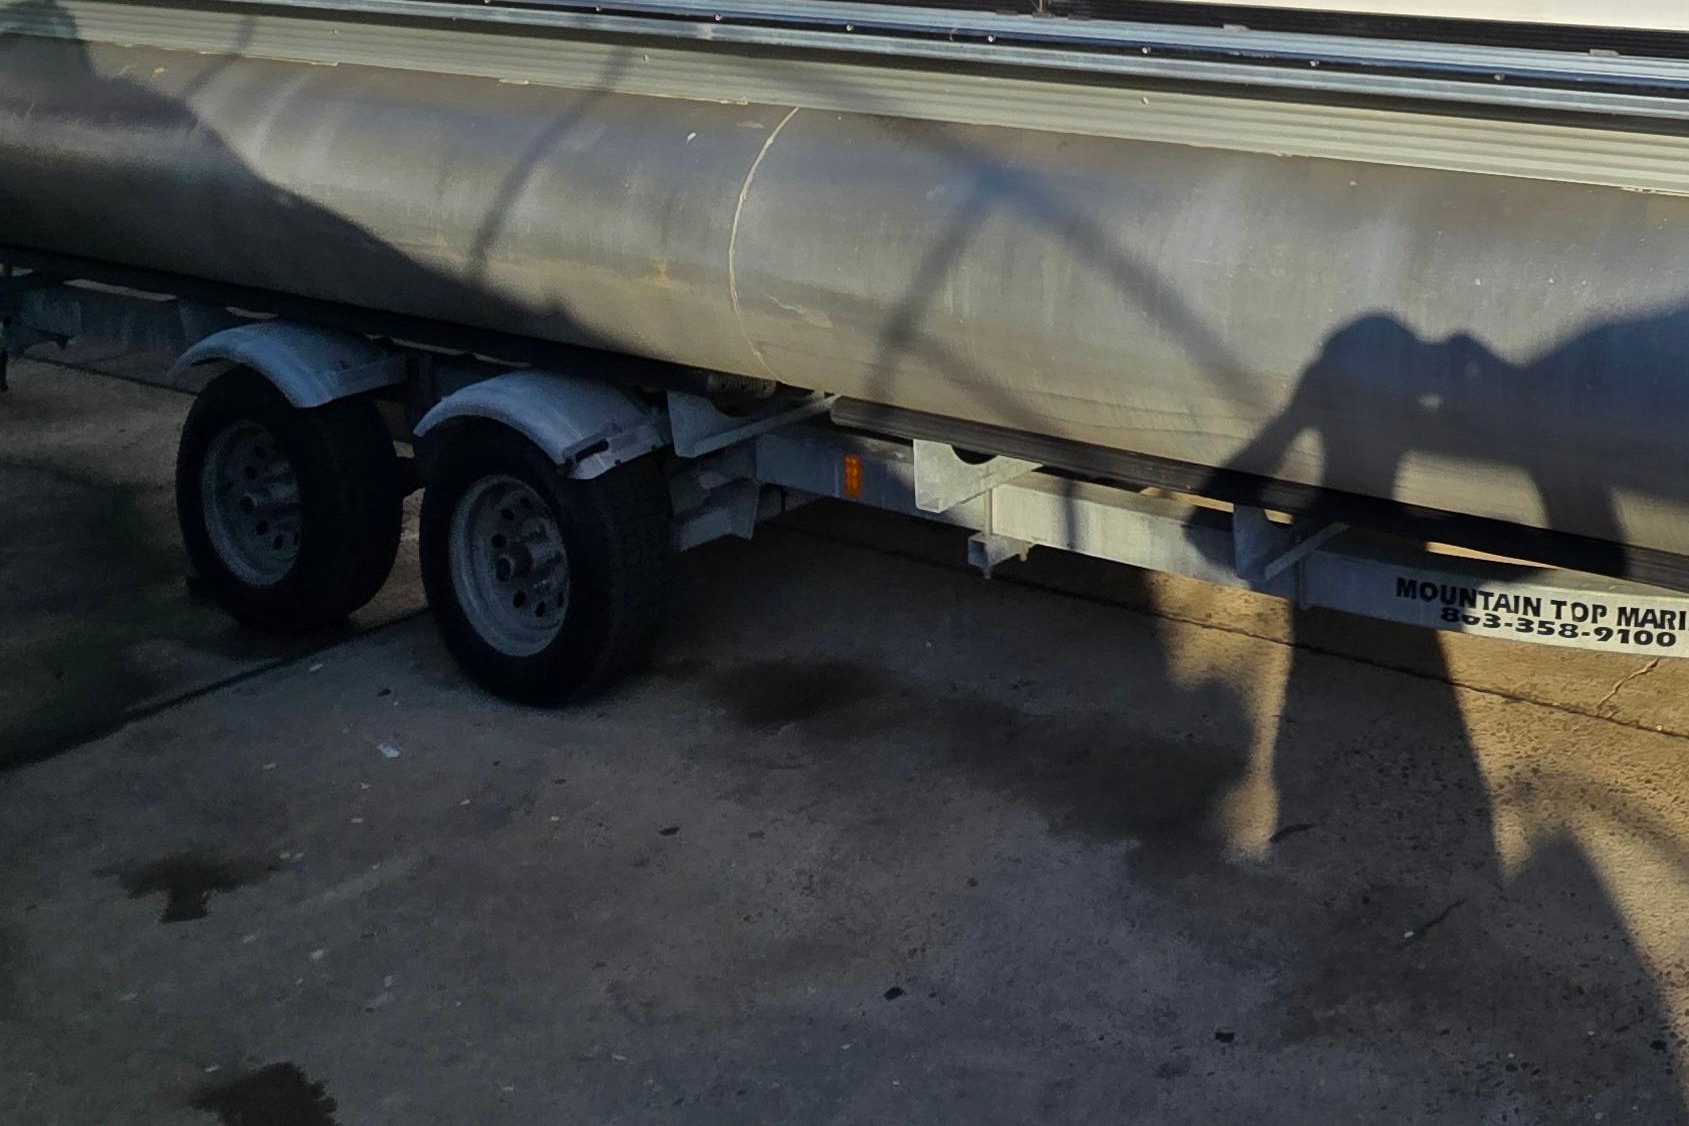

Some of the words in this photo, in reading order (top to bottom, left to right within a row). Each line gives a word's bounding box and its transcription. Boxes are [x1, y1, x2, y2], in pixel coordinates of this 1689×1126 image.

[1396, 577, 1541, 617] MOUNTAIN
[1550, 599, 1607, 624] TOP
[1440, 607, 1677, 647] 803-358-9100
